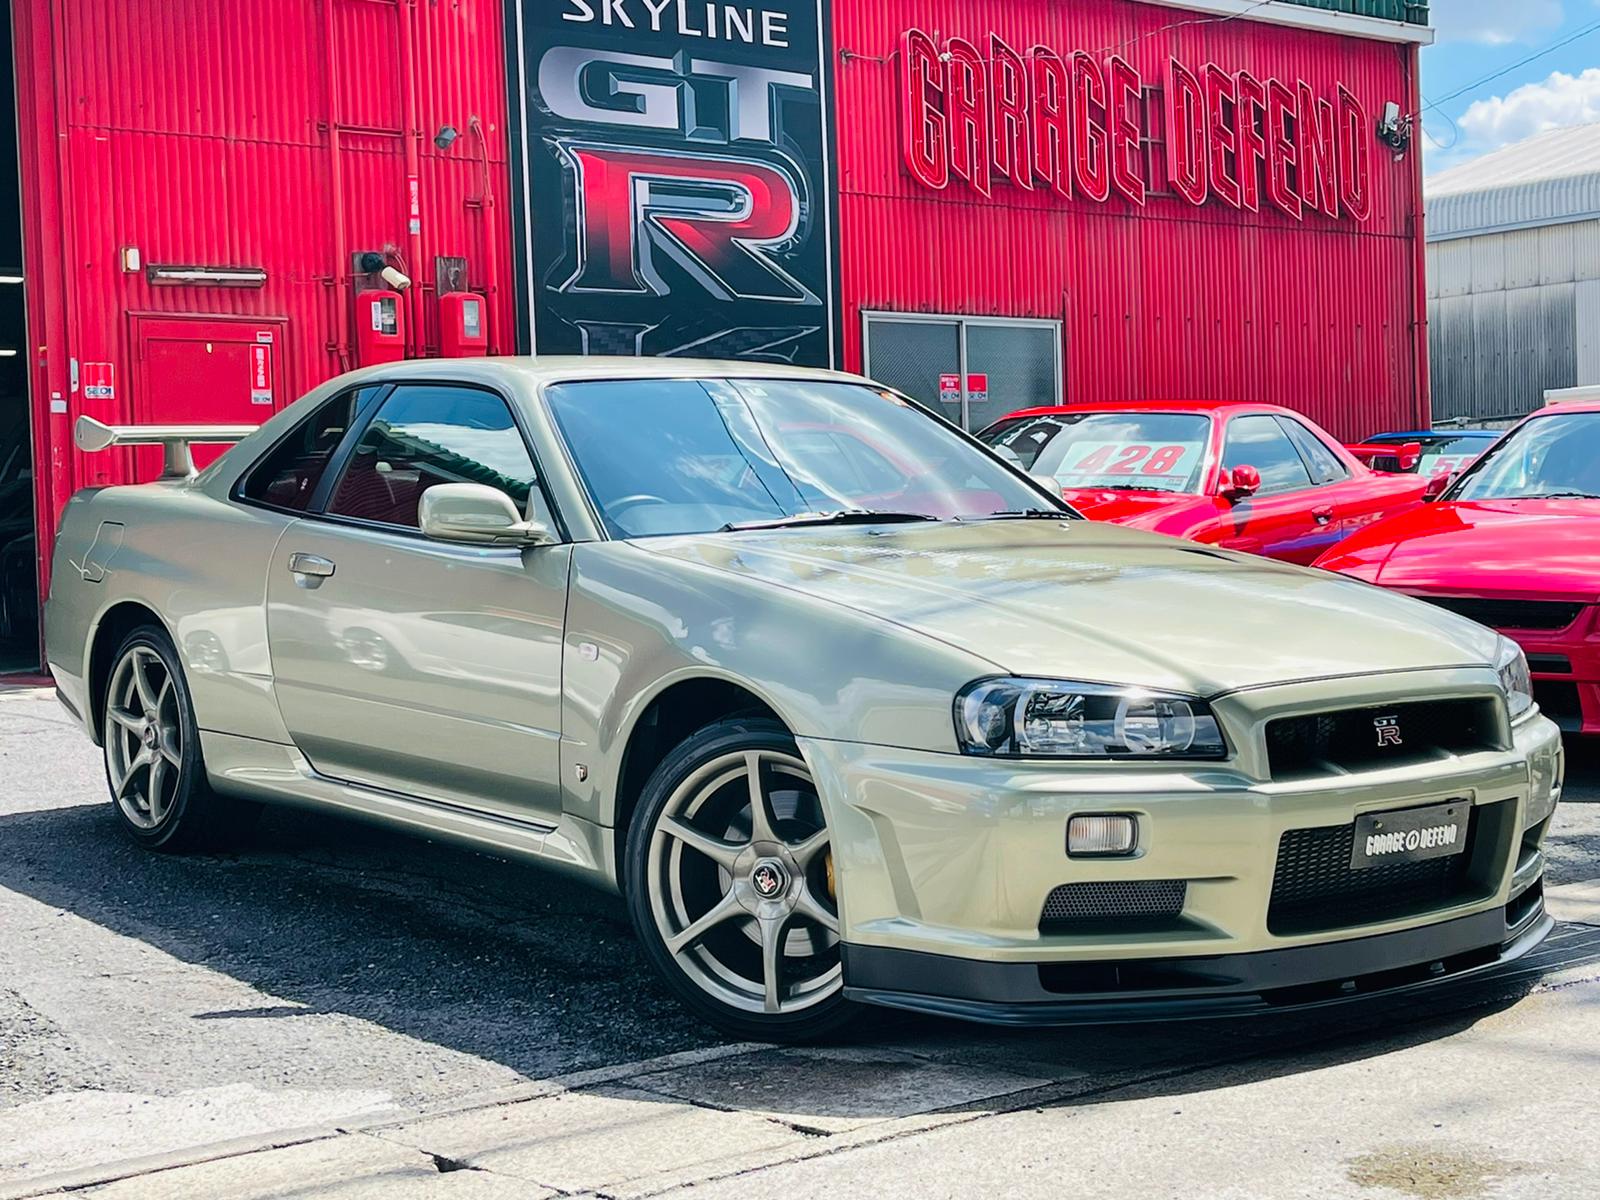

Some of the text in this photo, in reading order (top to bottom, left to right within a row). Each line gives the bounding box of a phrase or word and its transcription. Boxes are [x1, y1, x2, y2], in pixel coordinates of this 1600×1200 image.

[562, 0, 789, 48] SKYLINE
[538, 45, 813, 144] GT
[902, 28, 1371, 221] GARAGE DEFEND
[1073, 444, 1185, 475] 428
[1365, 823, 1458, 857] GARAGE DEFEND
